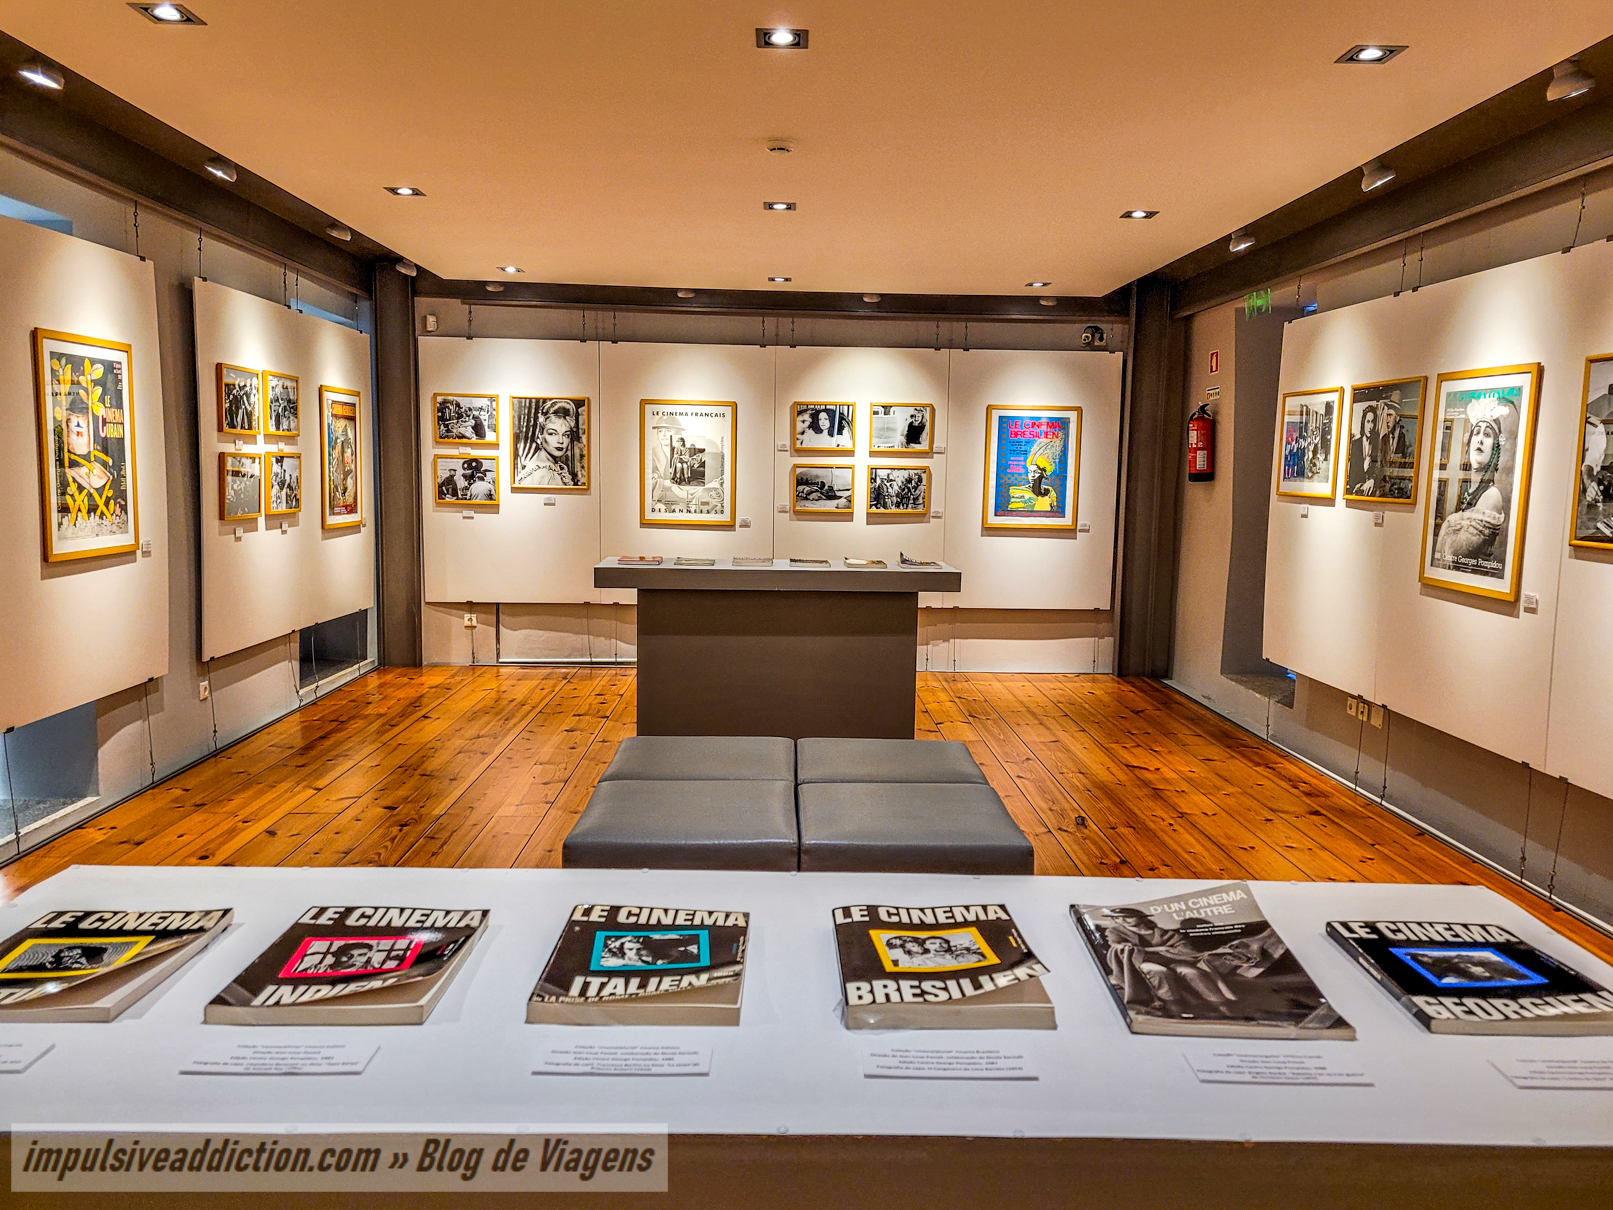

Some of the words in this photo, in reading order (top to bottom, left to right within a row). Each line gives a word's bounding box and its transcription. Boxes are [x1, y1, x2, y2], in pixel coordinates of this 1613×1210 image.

[1008, 420, 1021, 429] LE
[1023, 420, 1062, 430] CINEMA
[1009, 430, 1059, 439] BRESILIEN
[1457, 556, 1478, 566] Georges
[1478, 558, 1503, 569] Pompidou
[1149, 902, 1187, 914] D'UN
[1188, 889, 1248, 908] CINEMA
[1172, 904, 1235, 920] L'AUTRE
[28, 911, 84, 929] LE
[78, 909, 224, 931] CINEMA
[298, 907, 336, 925] LE
[345, 907, 484, 928] CINEMA
[571, 905, 611, 922] LE
[616, 906, 747, 927] CINEMA
[833, 905, 869, 925] LE
[877, 905, 1011, 925] CINEMA
[1330, 921, 1379, 940] LE
[1373, 922, 1520, 942] CINEMA
[250, 977, 399, 1007] INDIEN
[567, 973, 710, 998] ITALIEN
[845, 963, 1049, 1006] BRESILIEN
[1409, 990, 1613, 1021] GEORGIEN
